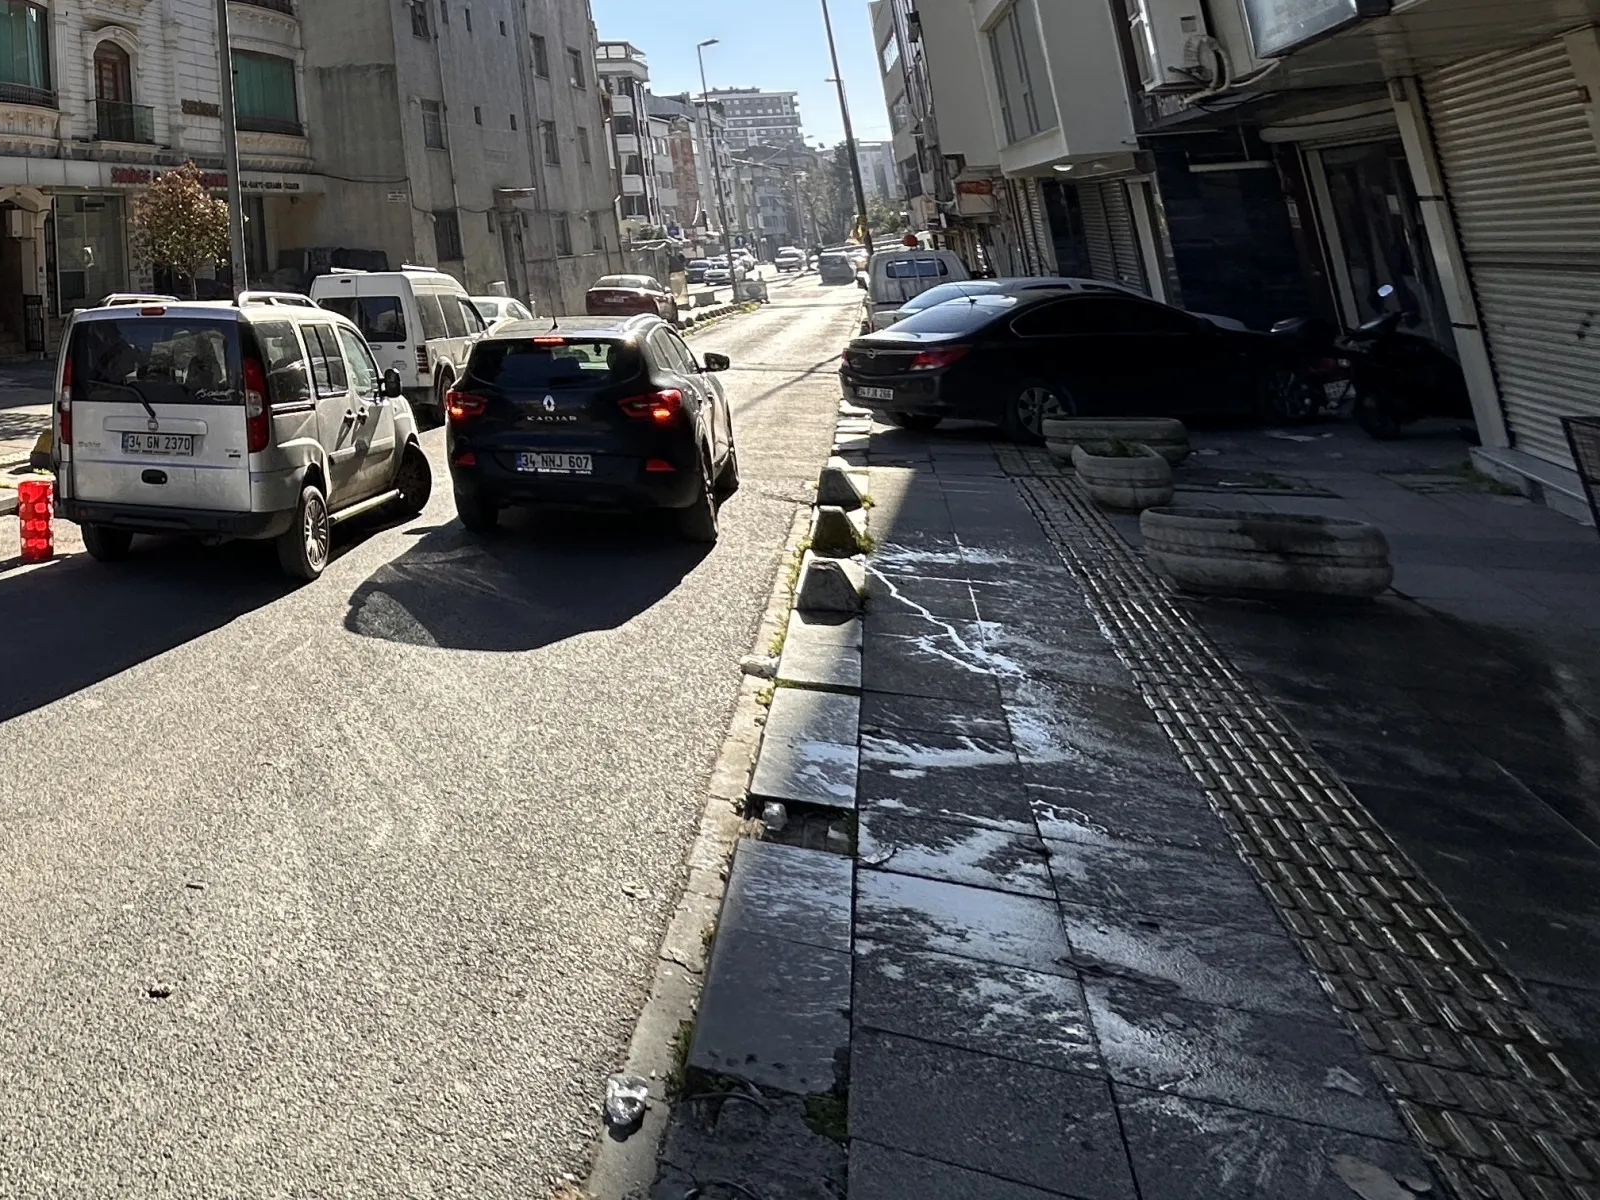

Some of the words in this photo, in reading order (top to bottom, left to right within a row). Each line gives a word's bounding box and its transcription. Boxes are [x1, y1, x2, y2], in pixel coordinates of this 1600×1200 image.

[128, 435, 142, 448] 34
[146, 436, 160, 449] GN
[164, 437, 191, 451] 2370
[522, 454, 536, 468] 34
[541, 455, 563, 468] NNJ
[568, 455, 590, 468] 607
